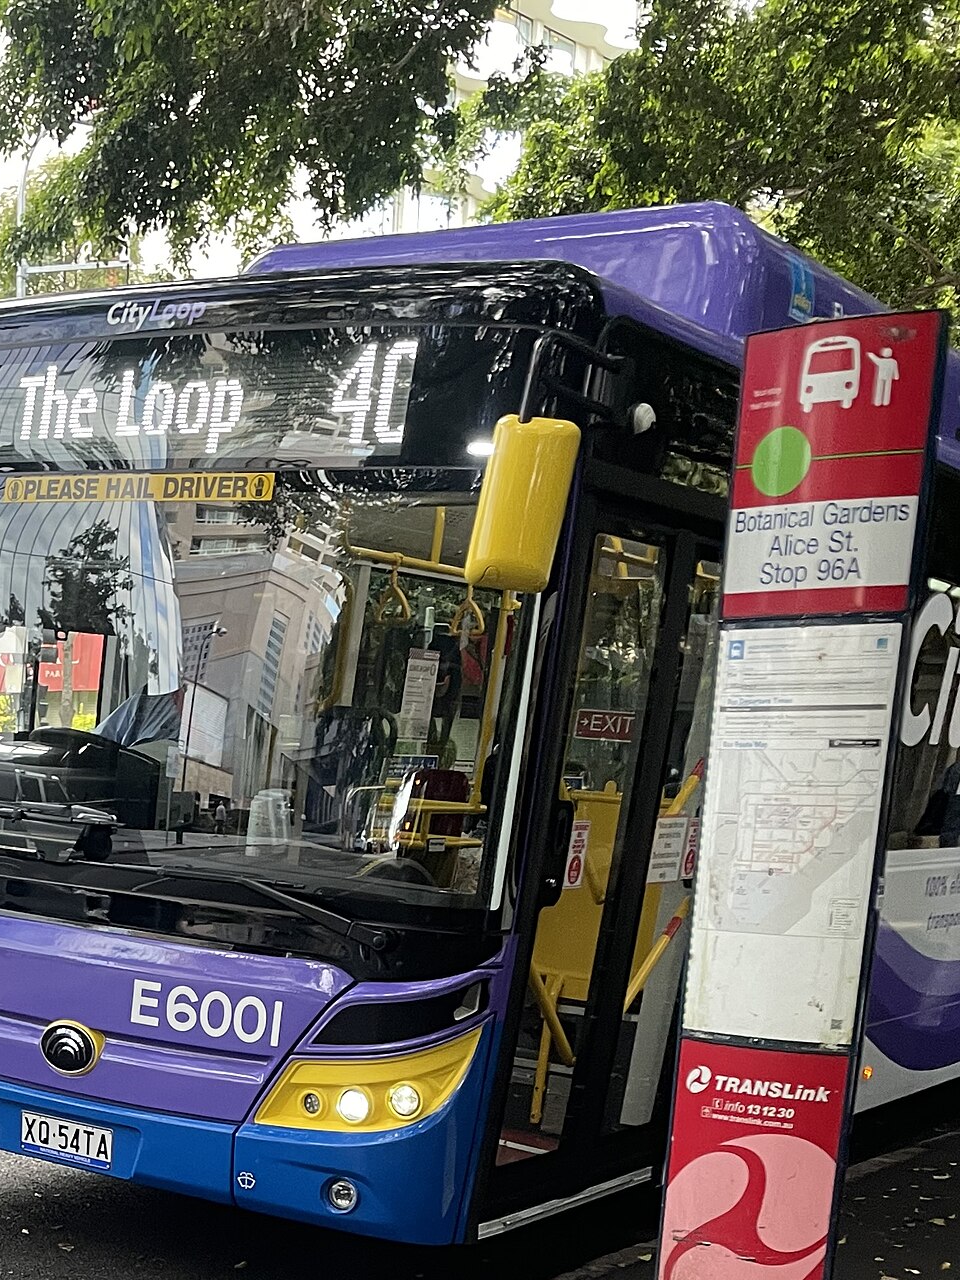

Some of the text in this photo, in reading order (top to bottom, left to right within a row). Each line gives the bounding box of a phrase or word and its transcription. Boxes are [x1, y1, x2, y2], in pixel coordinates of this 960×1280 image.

[20, 364, 99, 440] The
[115, 369, 244, 454] Loop
[24, 476, 248, 500] PLEASE HAIL DRIVER
[735, 500, 910, 533] Botanical Gardens
[768, 530, 858, 557] Alice St.
[759, 557, 861, 588] Stop 96A
[590, 714, 636, 734] EXIT
[131, 979, 283, 1047] E6001
[715, 1075, 831, 1102] TRANSLink
[724, 1100, 746, 1113] info
